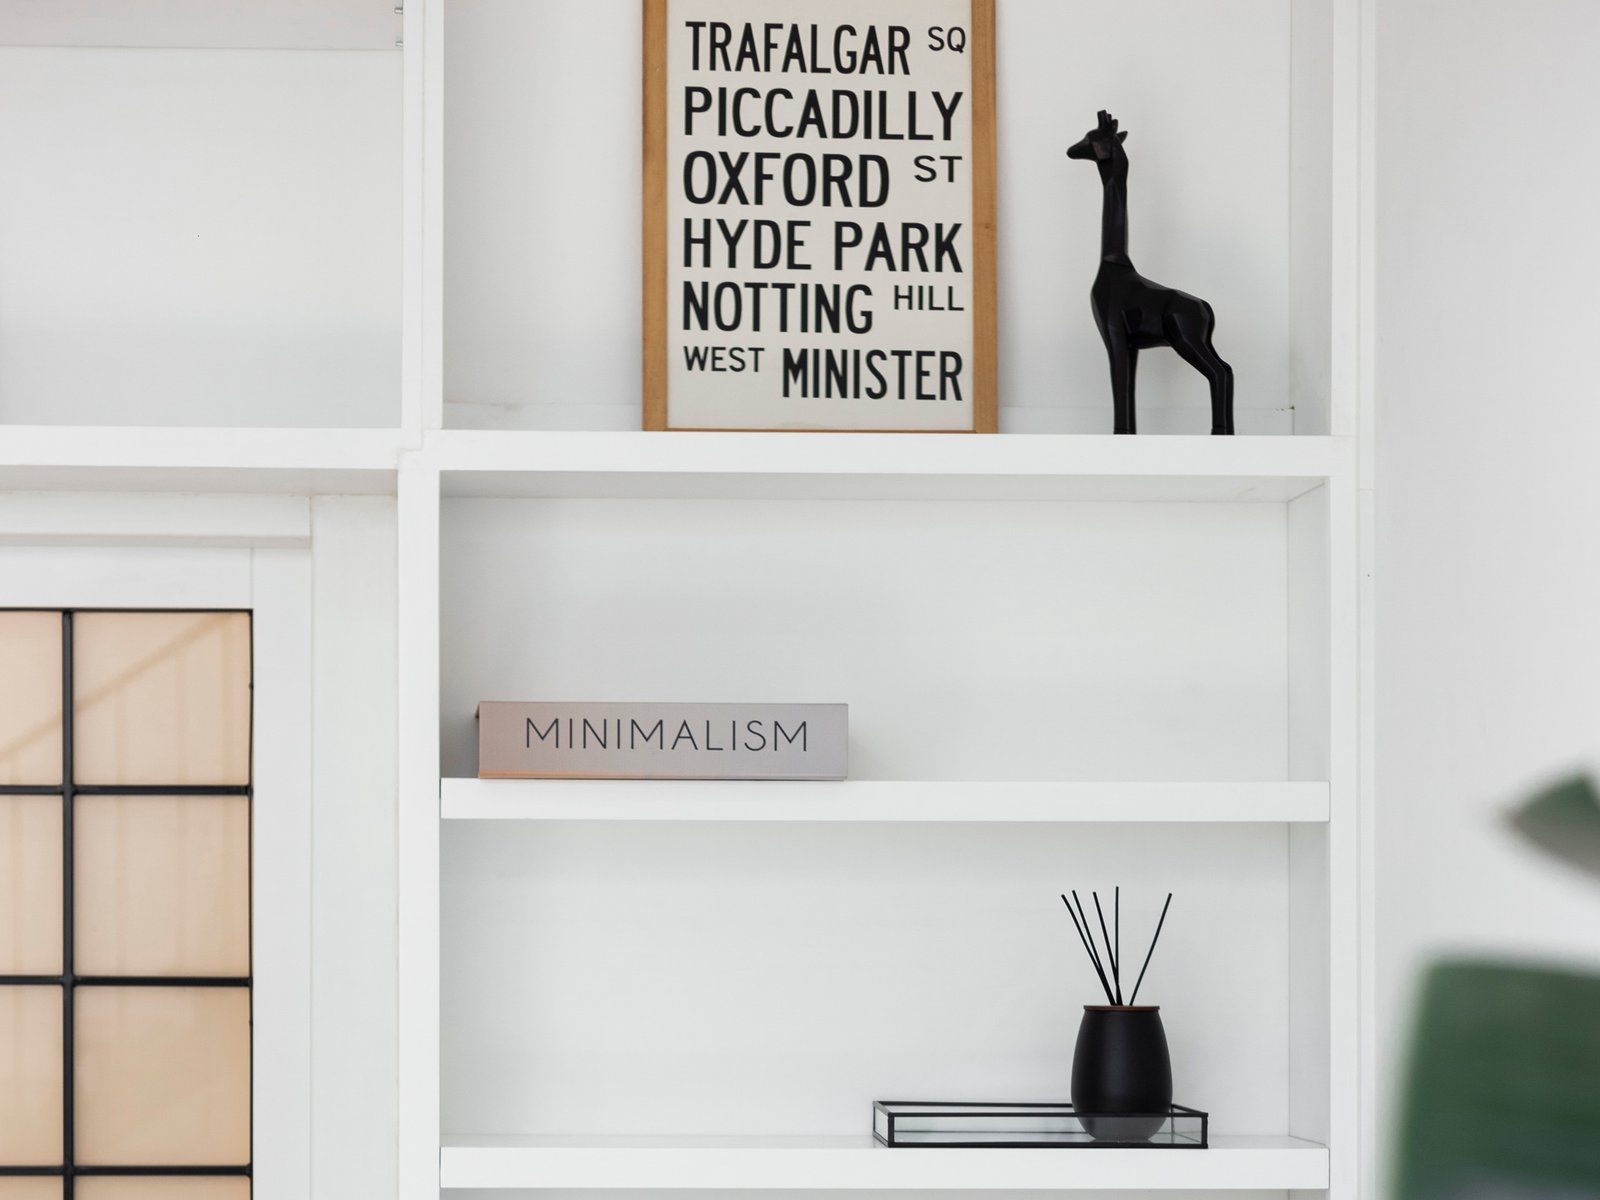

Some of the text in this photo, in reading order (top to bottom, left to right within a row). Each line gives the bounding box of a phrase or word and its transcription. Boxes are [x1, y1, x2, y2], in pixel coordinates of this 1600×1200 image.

[685, 20, 967, 76] TRAFALGAR SQ
[684, 85, 964, 141] PICCADILLY
[683, 150, 963, 208] OXFORD ST
[683, 217, 963, 273] HYDE PARK
[683, 280, 965, 335] NOTTING HILL
[683, 345, 963, 402] WEST MINISTER
[525, 717, 808, 752] MINIMALISM
